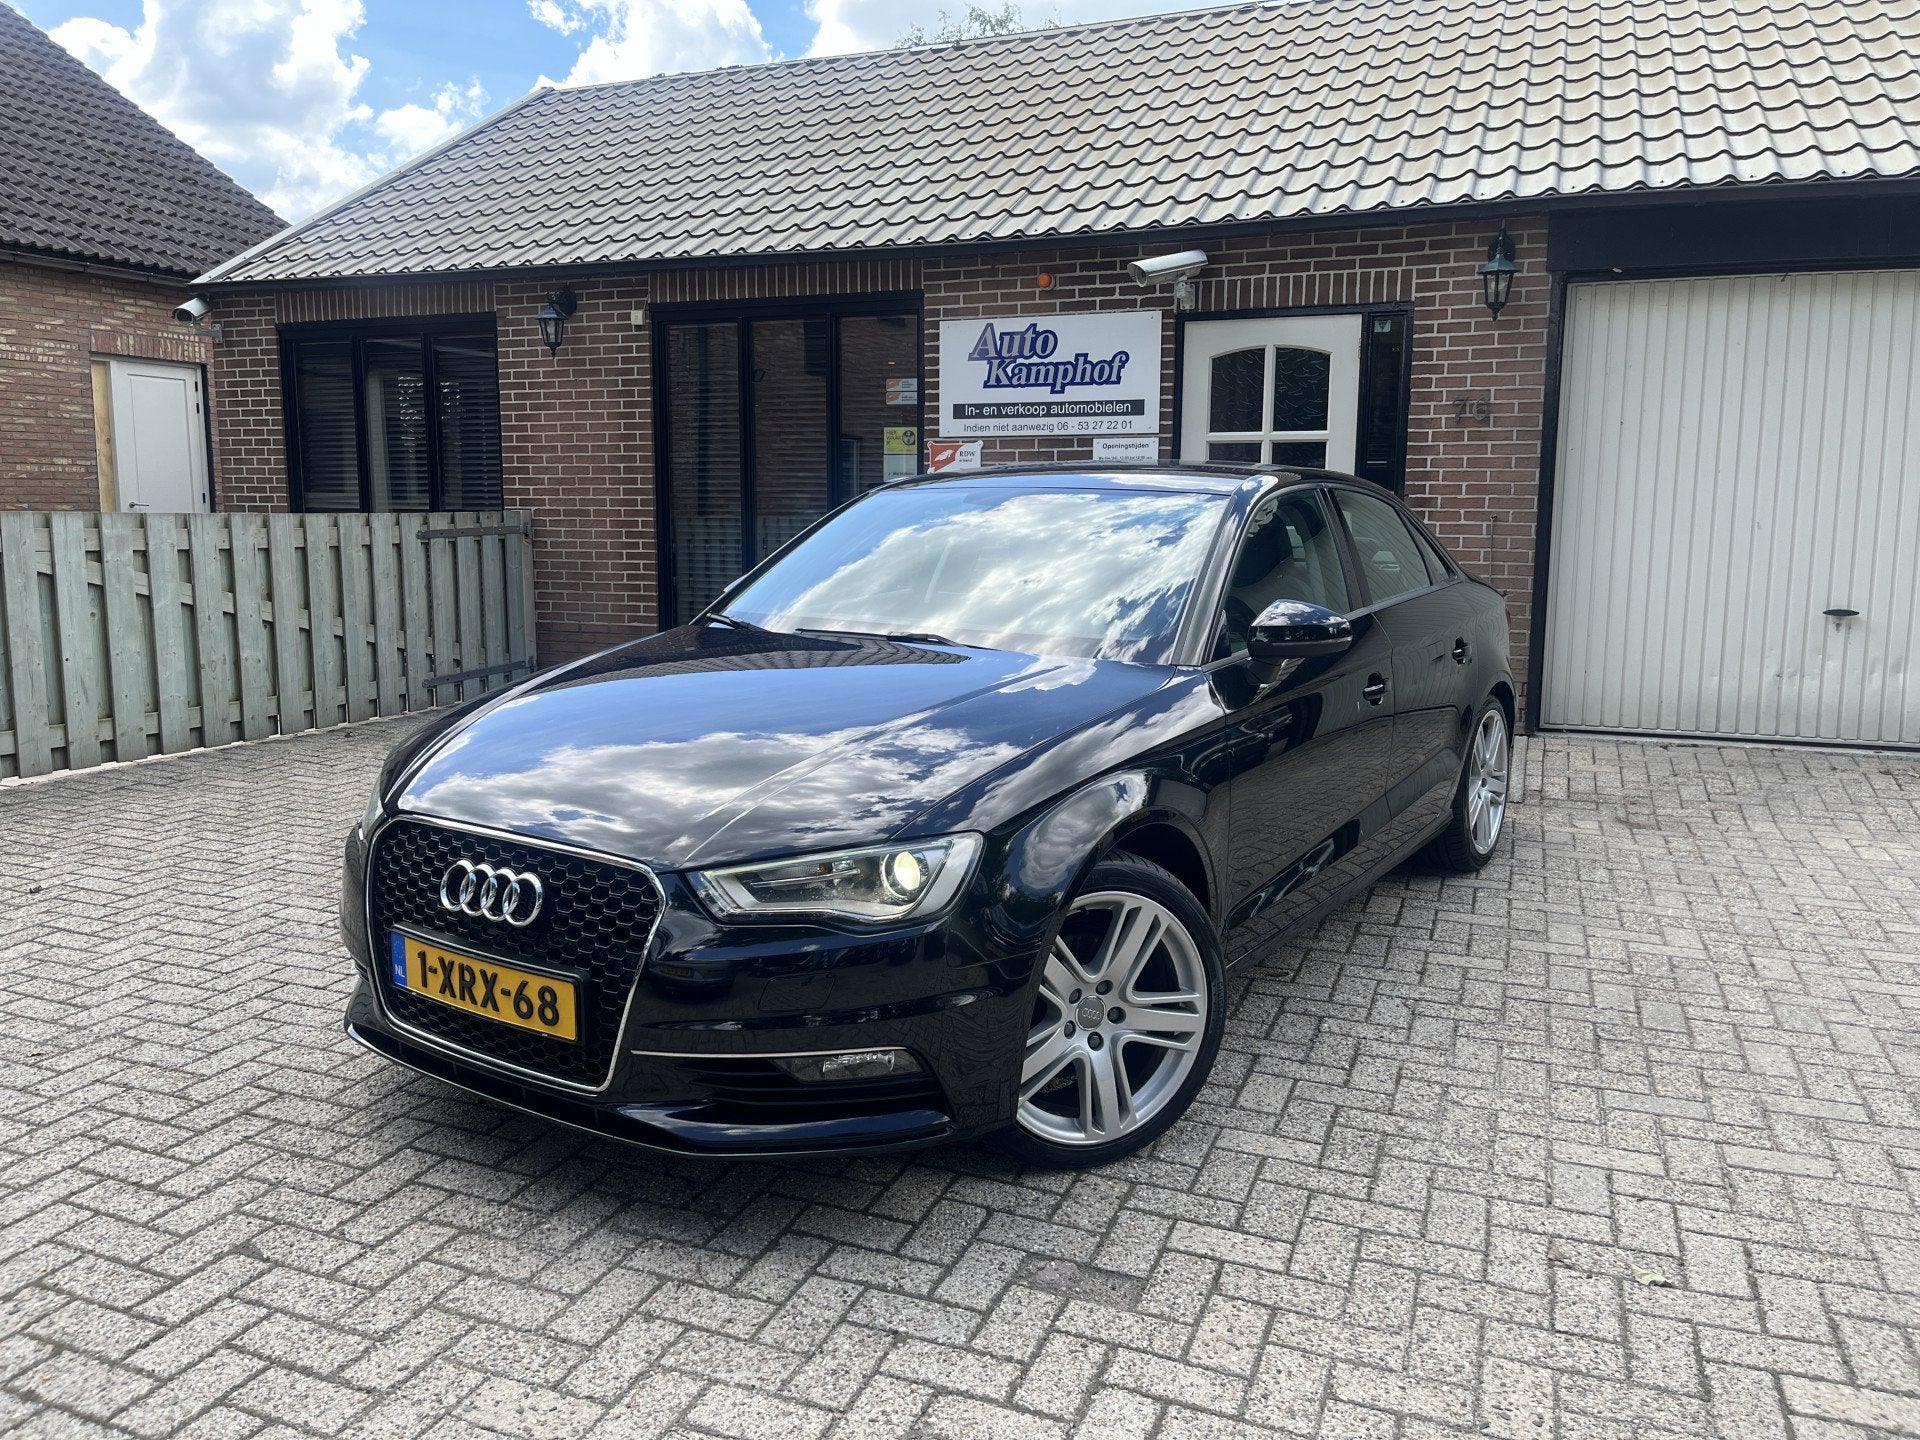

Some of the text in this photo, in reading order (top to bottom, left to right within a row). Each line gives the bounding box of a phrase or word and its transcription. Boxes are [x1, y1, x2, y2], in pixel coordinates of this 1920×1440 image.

[968, 322, 1058, 361] Auto
[983, 350, 1130, 394] Kamphof
[965, 401, 1131, 417] In- en verkoop automobielen
[963, 424, 990, 432] Indien
[993, 423, 1009, 432] niet
[1011, 422, 1055, 432] aanwezig
[1057, 422, 1069, 431] 06
[1077, 421, 1089, 430] 53
[1092, 421, 1103, 430] 27
[1106, 420, 1118, 429] 22
[1121, 420, 1132, 429] 01
[395, 966, 406, 978] NL
[417, 950, 559, 1027] 1-XRX-68
